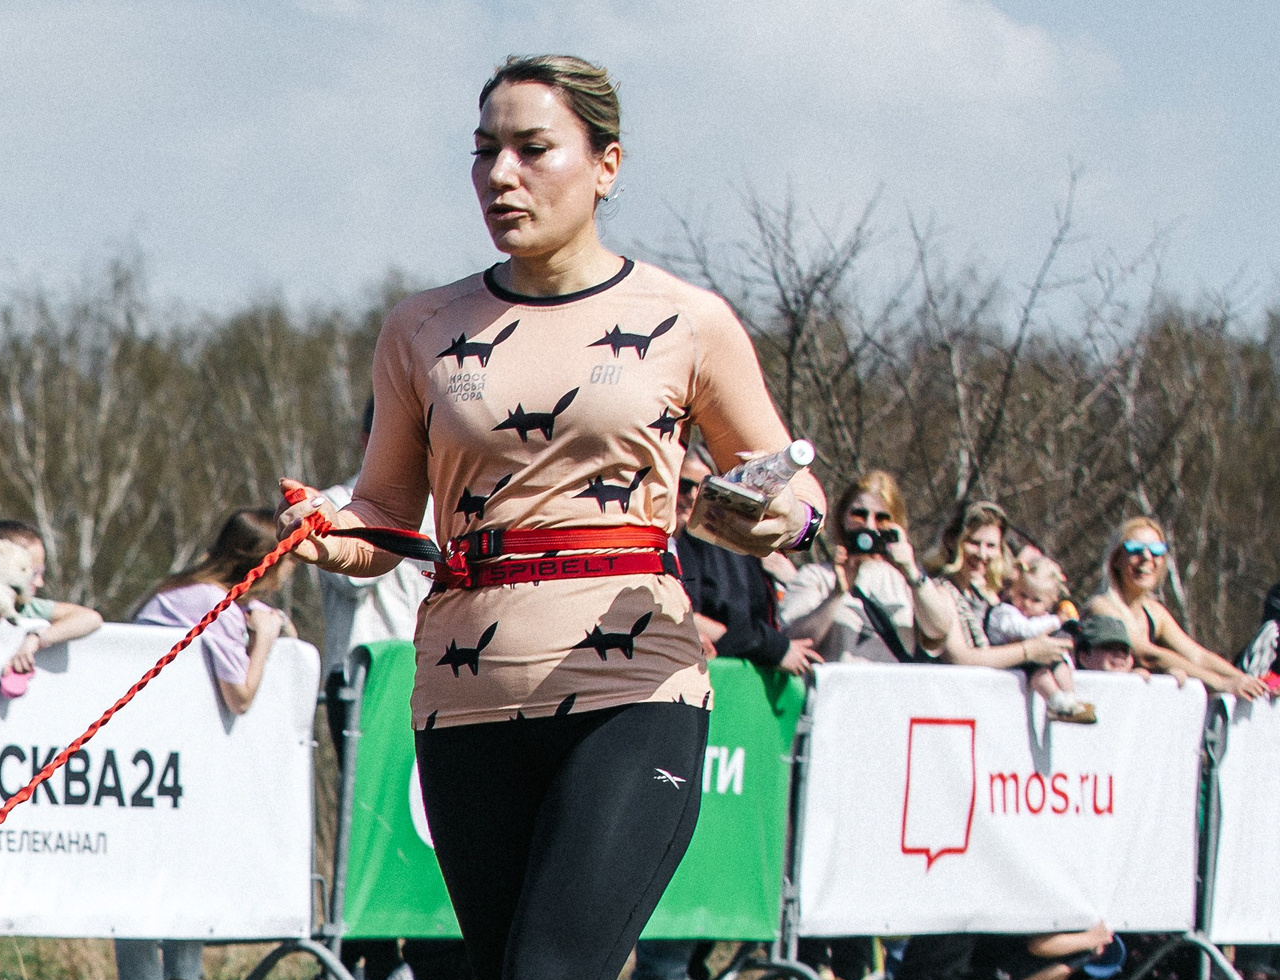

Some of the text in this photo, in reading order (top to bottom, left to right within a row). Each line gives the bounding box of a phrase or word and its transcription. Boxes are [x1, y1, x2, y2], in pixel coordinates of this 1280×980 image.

[449, 373, 487, 384] КРОСС
[446, 382, 486, 395] ЛИСЬЯ
[455, 391, 483, 402] ГОРА
[489, 556, 619, 582] SPIBELT
[989, 772, 1114, 815] mos.ru
